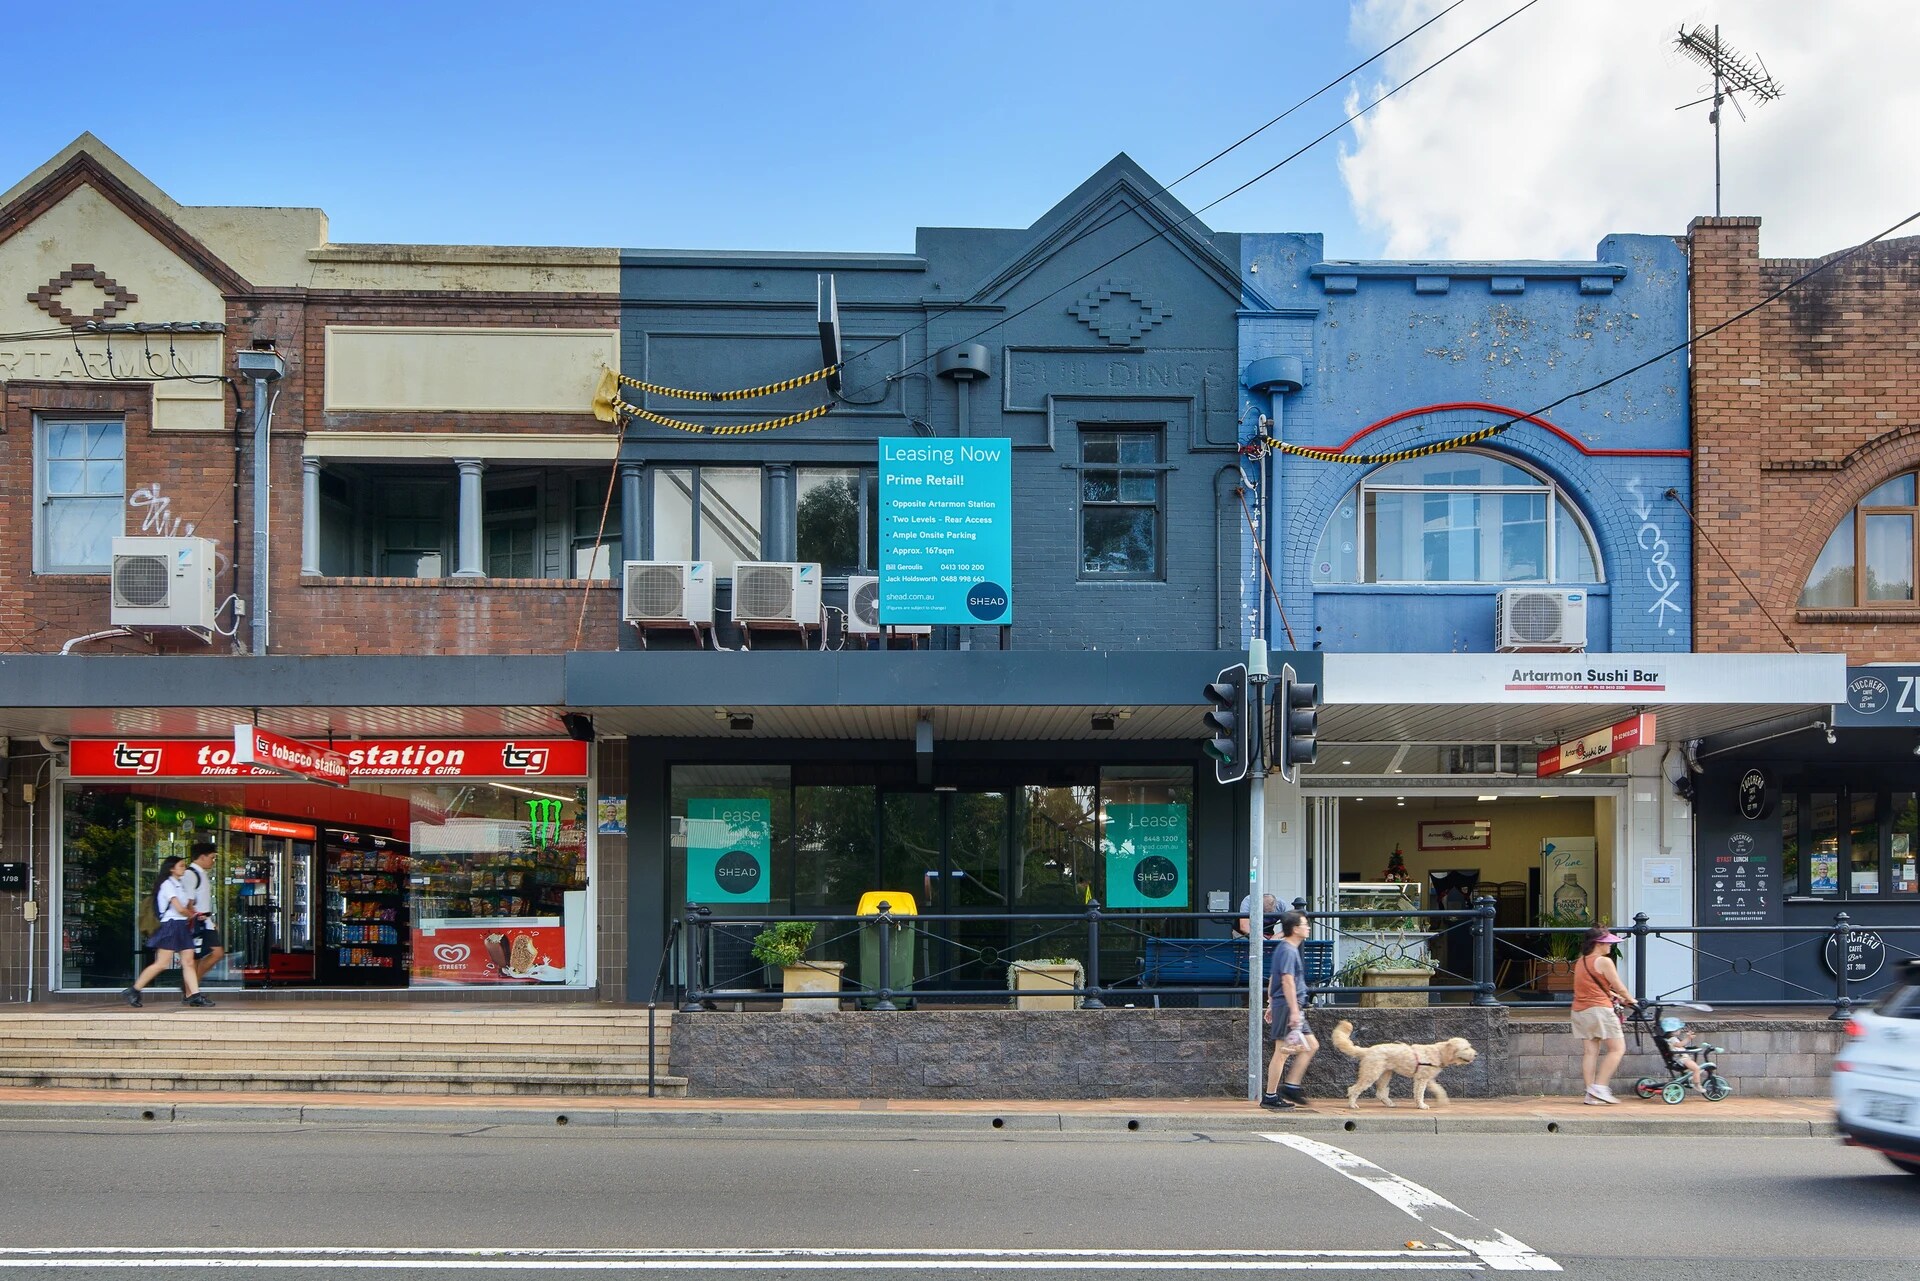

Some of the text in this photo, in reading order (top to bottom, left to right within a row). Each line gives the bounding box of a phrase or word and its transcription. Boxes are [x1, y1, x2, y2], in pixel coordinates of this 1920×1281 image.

[1014, 361, 1225, 388] BUILDINGS
[885, 445, 1000, 465] Leasing Now
[886, 474, 964, 485] Prime Retail!
[892, 500, 926, 508] Opposite
[892, 532, 917, 540] Ample
[947, 532, 976, 540] Parking
[892, 547, 954, 555] Approx. 167sqm
[1512, 670, 1658, 682] Artarmon Sushi Bar
[1850, 680, 1885, 693] ZUCCHERO
[114, 742, 162, 774] tsg
[348, 745, 464, 765] station
[502, 742, 549, 774] tsg
[1583, 746, 1597, 760] Sushi
[1598, 744, 1607, 753] Bar
[272, 742, 312, 766] tobacco
[314, 757, 346, 776] station
[201, 766, 238, 775] Drinks
[350, 766, 461, 775] Accessories & Gifts
[1130, 813, 1178, 827] Lease
[719, 868, 757, 876] SHEAD
[1137, 873, 1175, 881] SHEAD
